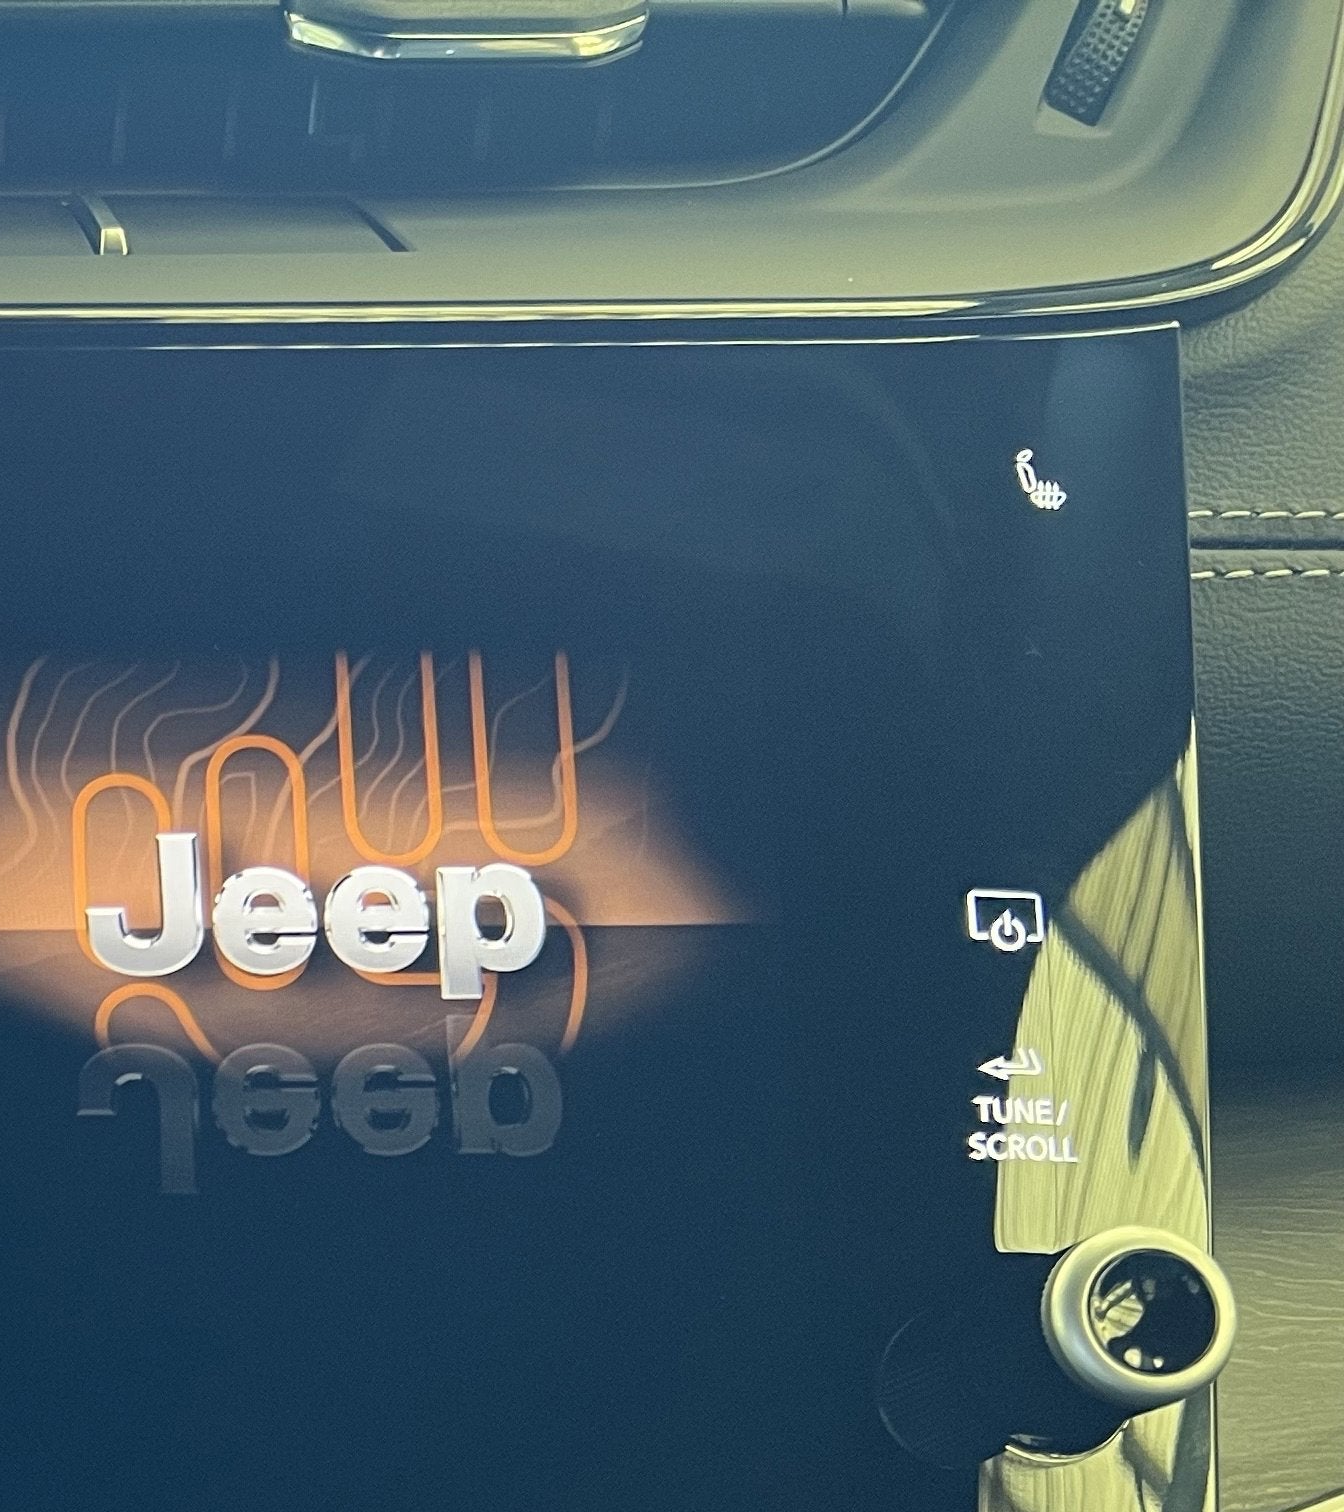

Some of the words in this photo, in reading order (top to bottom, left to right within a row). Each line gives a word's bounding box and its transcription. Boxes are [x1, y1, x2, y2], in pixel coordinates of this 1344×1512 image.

[86, 833, 546, 1000] Jeep
[971, 1095, 1068, 1126] TUNE/
[968, 1132, 1078, 1162] SCROLL
